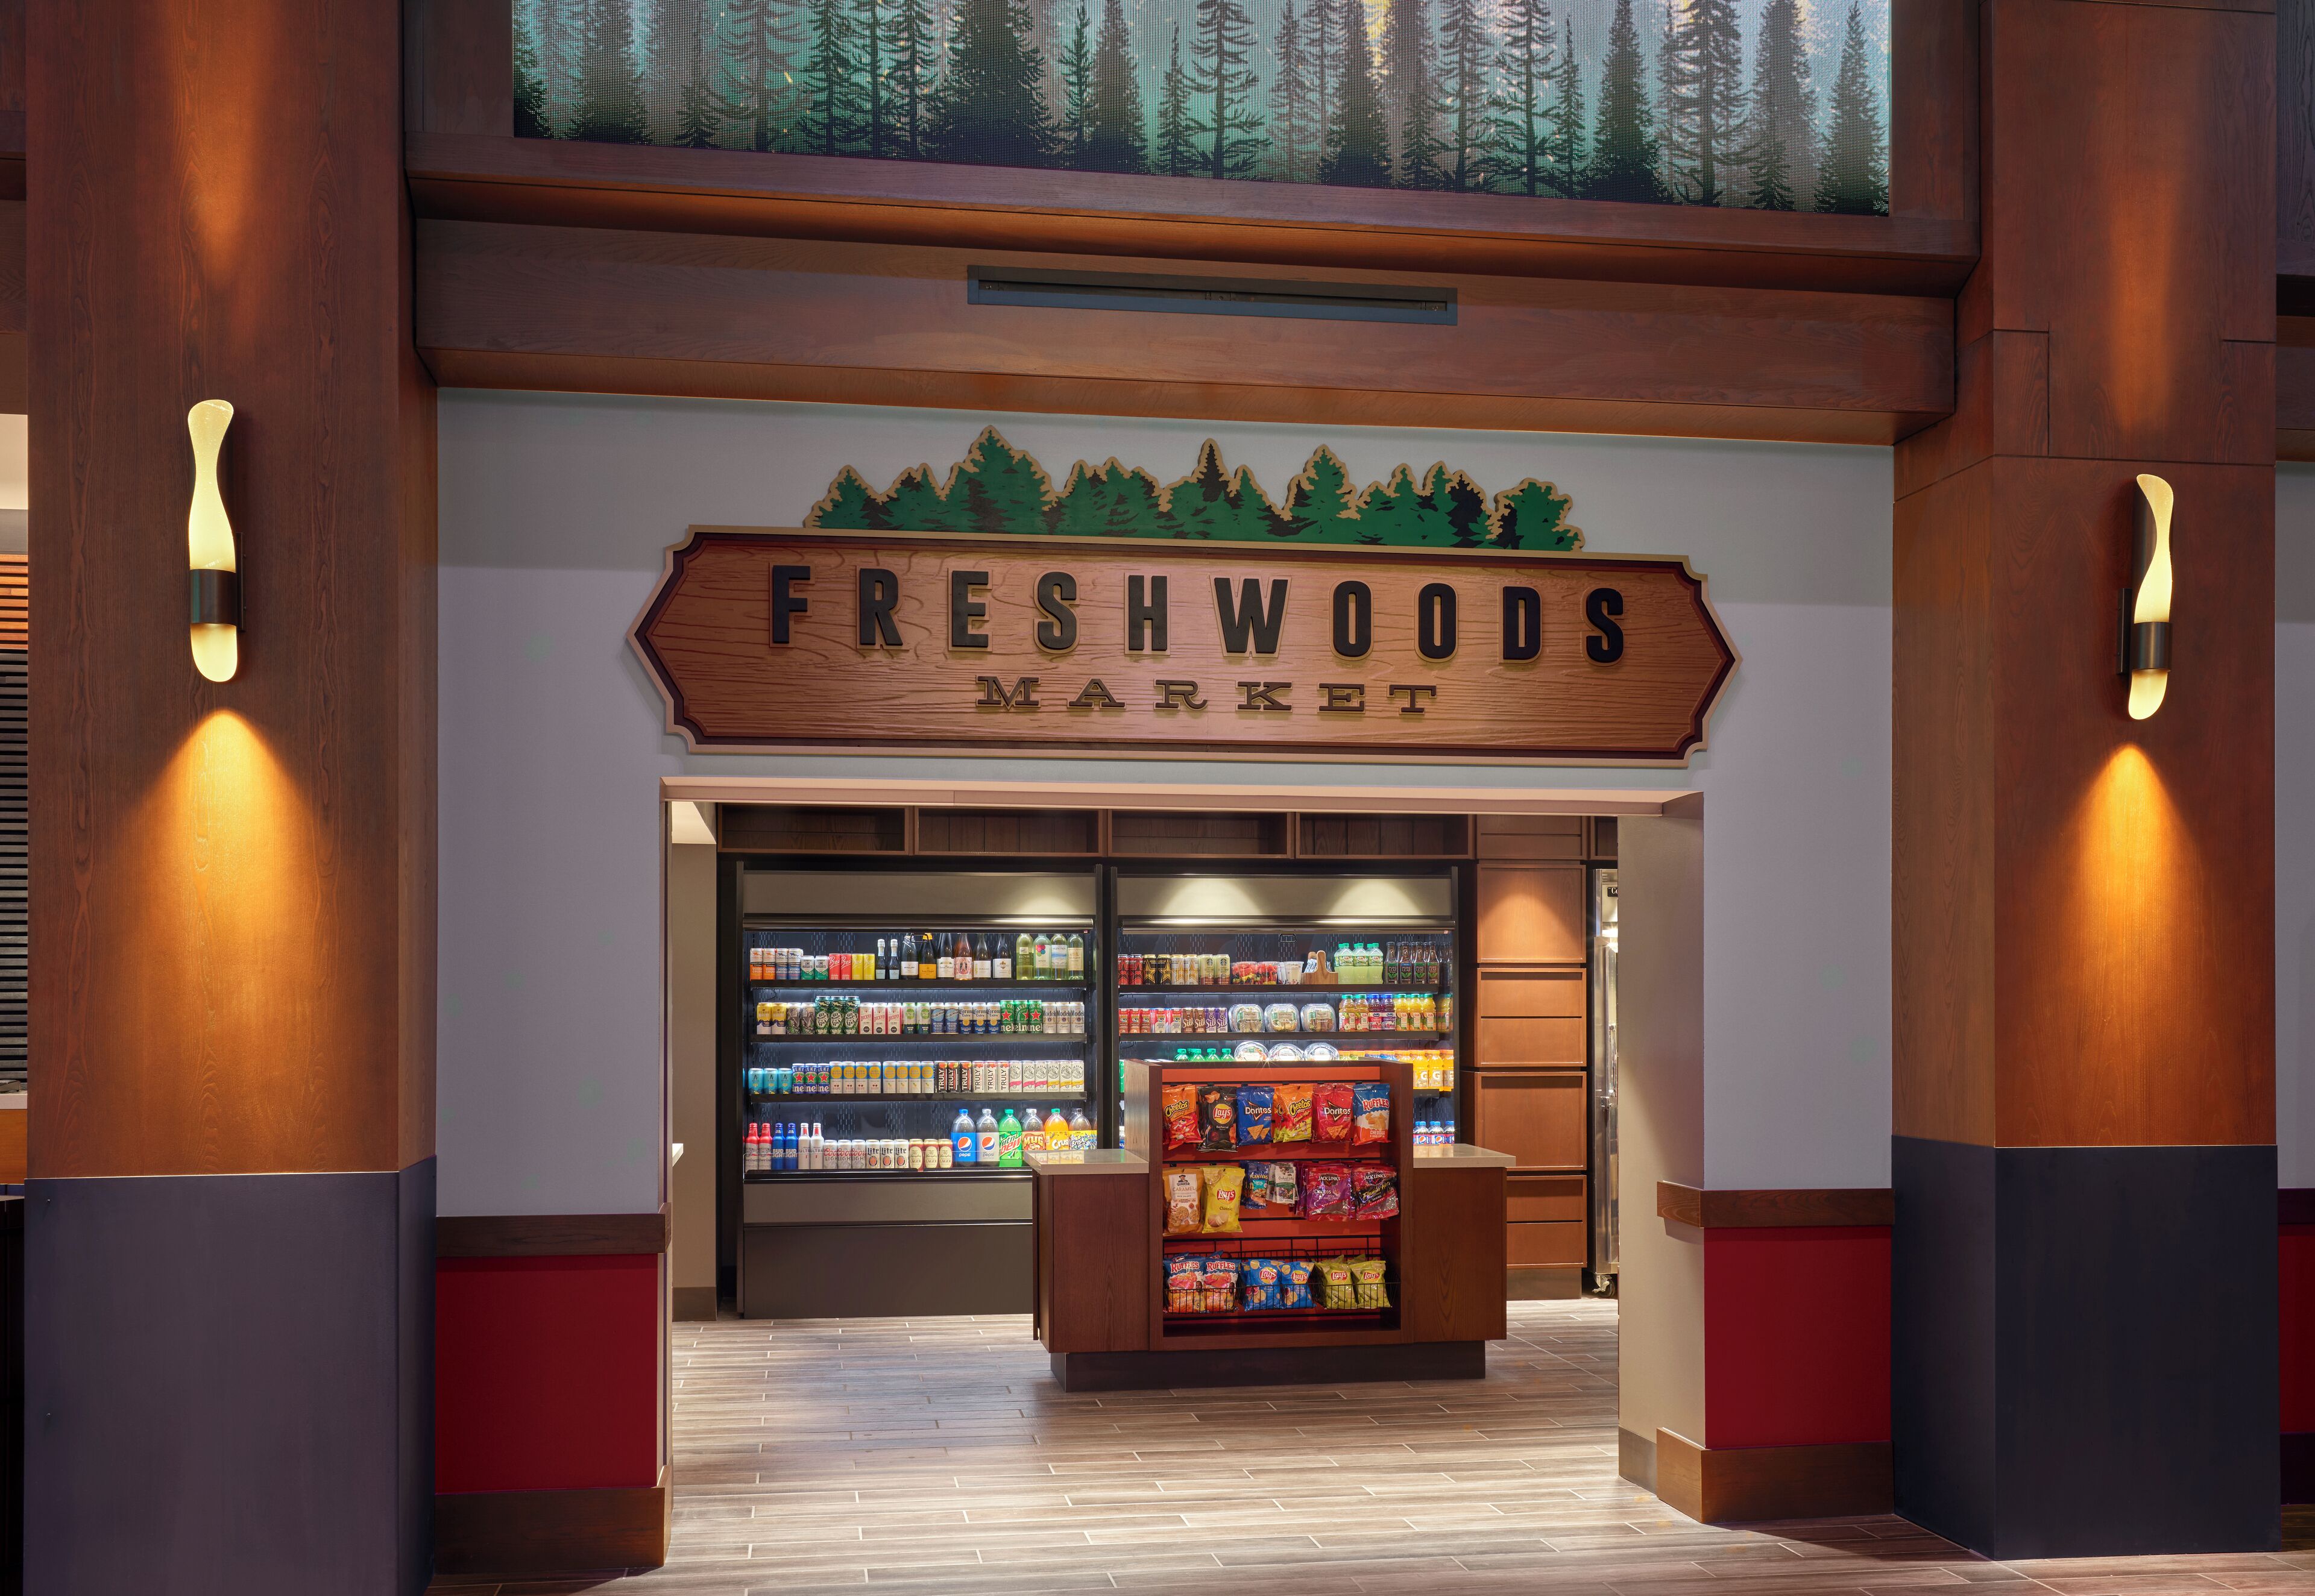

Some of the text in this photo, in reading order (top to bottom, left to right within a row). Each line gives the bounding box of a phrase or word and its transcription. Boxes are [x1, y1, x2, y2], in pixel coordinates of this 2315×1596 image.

[771, 564, 1624, 664] FRESHWOODS
[975, 674, 1437, 714] MARKET
[1183, 1017, 1194, 1028] Silk
[1194, 1017, 1205, 1028] Silk
[1206, 1017, 1217, 1028] Silk
[1217, 1017, 1227, 1028] Silk
[1420, 1071, 1428, 1080] G
[1432, 1071, 1440, 1080] G
[1165, 1101, 1189, 1118] Cheetos
[1289, 1099, 1311, 1116] Cheetos
[1362, 1098, 1390, 1111] RUFFLES
[1214, 1108, 1231, 1119] Lay's
[1024, 1136, 1044, 1147] MUG
[1171, 1261, 1200, 1274] RUFFLES
[1206, 1261, 1235, 1272] RUFFLES
[1261, 1271, 1276, 1281] Lay's
[1293, 1273, 1307, 1282] Lay's
[1332, 1272, 1347, 1281] Lay's
